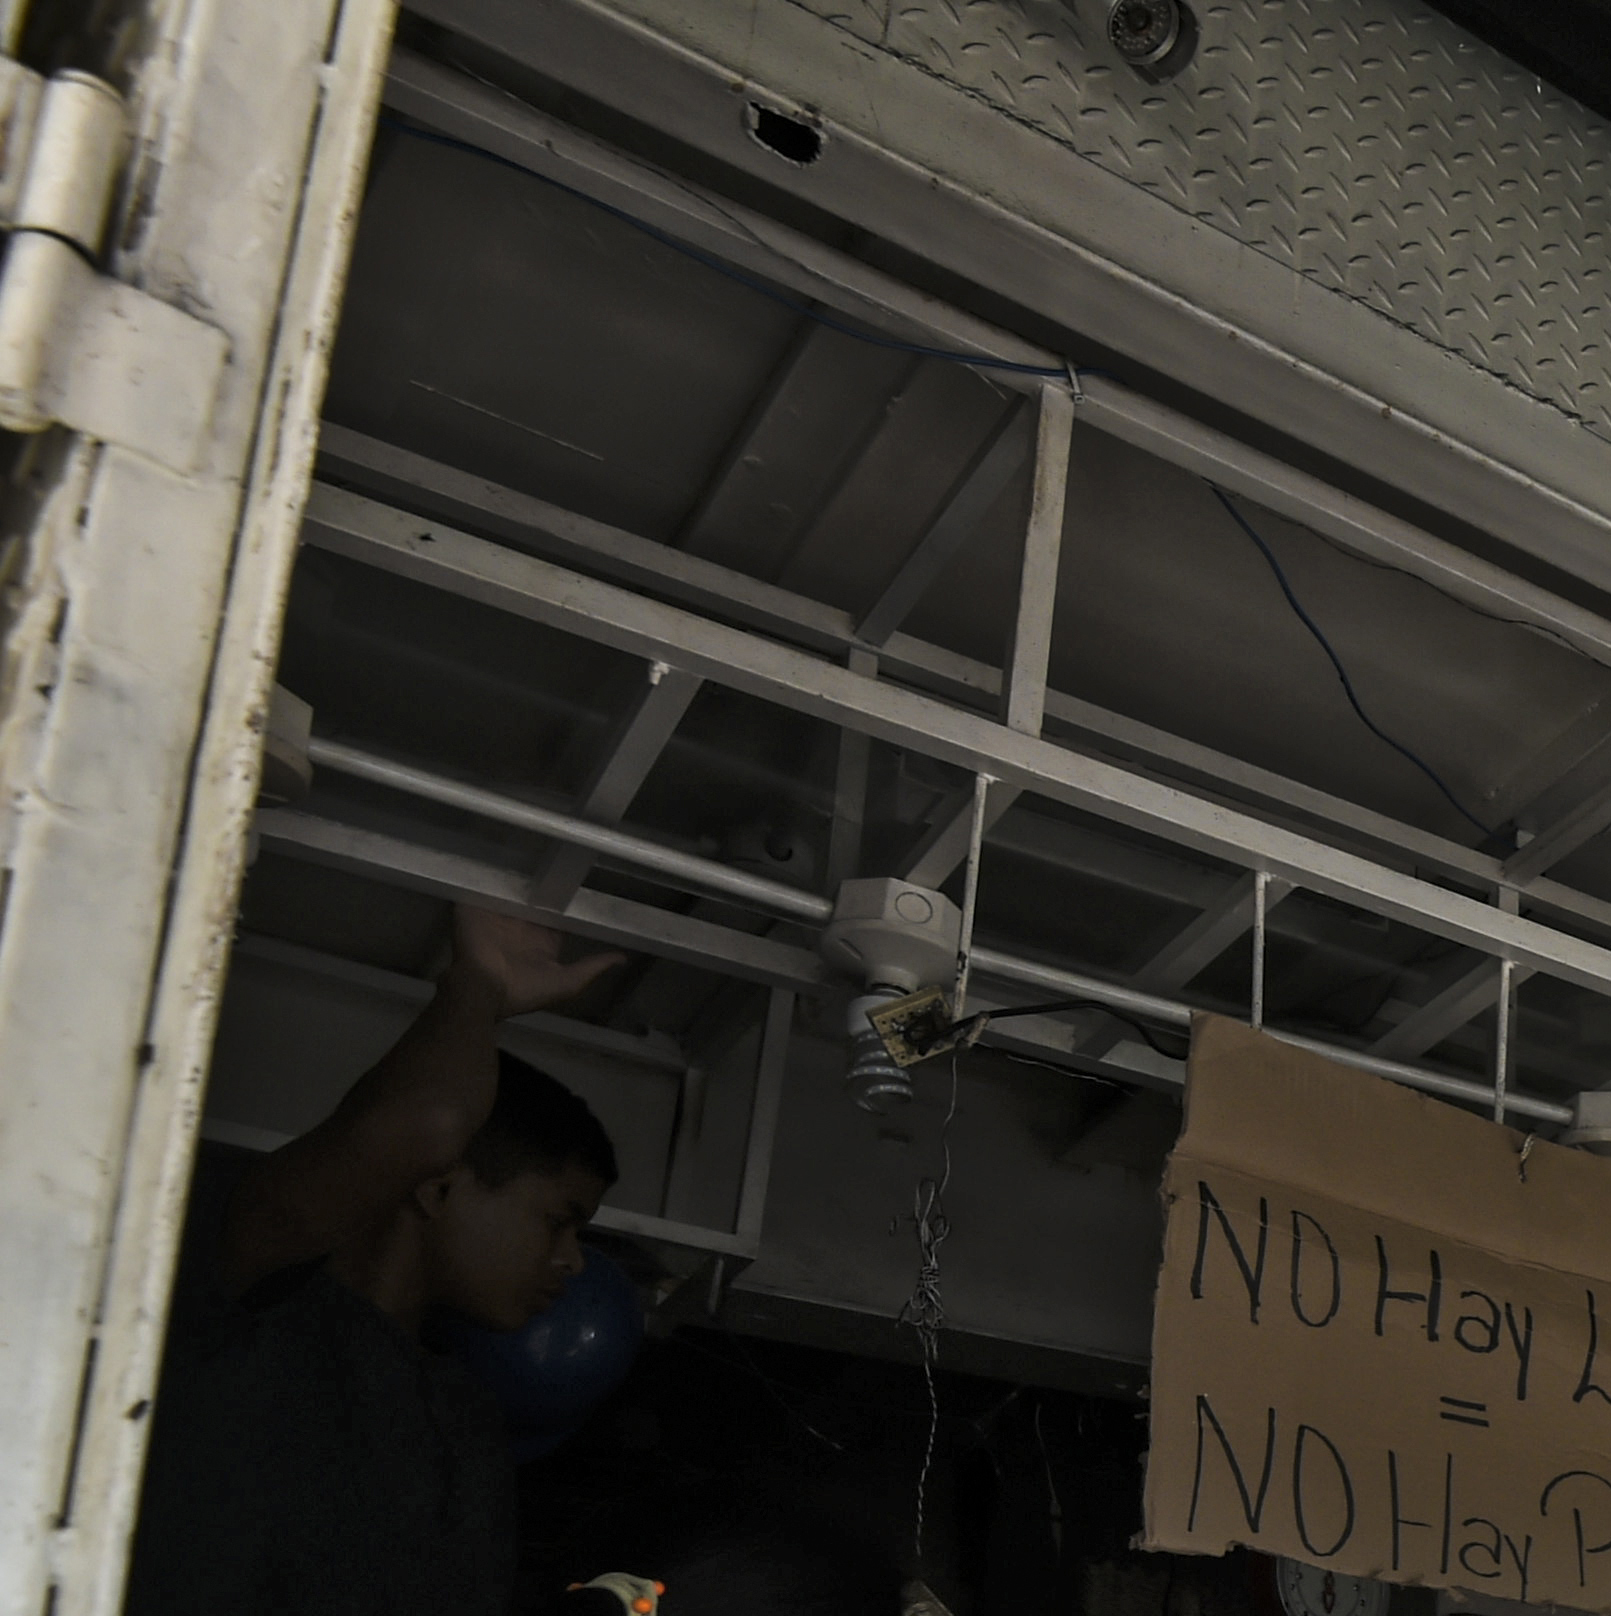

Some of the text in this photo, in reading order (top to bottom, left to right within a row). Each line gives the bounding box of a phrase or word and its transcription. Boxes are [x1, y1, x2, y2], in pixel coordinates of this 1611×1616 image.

[1191, 1181, 1340, 1328] NO
[1374, 1235, 1533, 1400] Hay
[1188, 1394, 1354, 1557] NO
[1388, 1449, 1532, 1600] Hay
